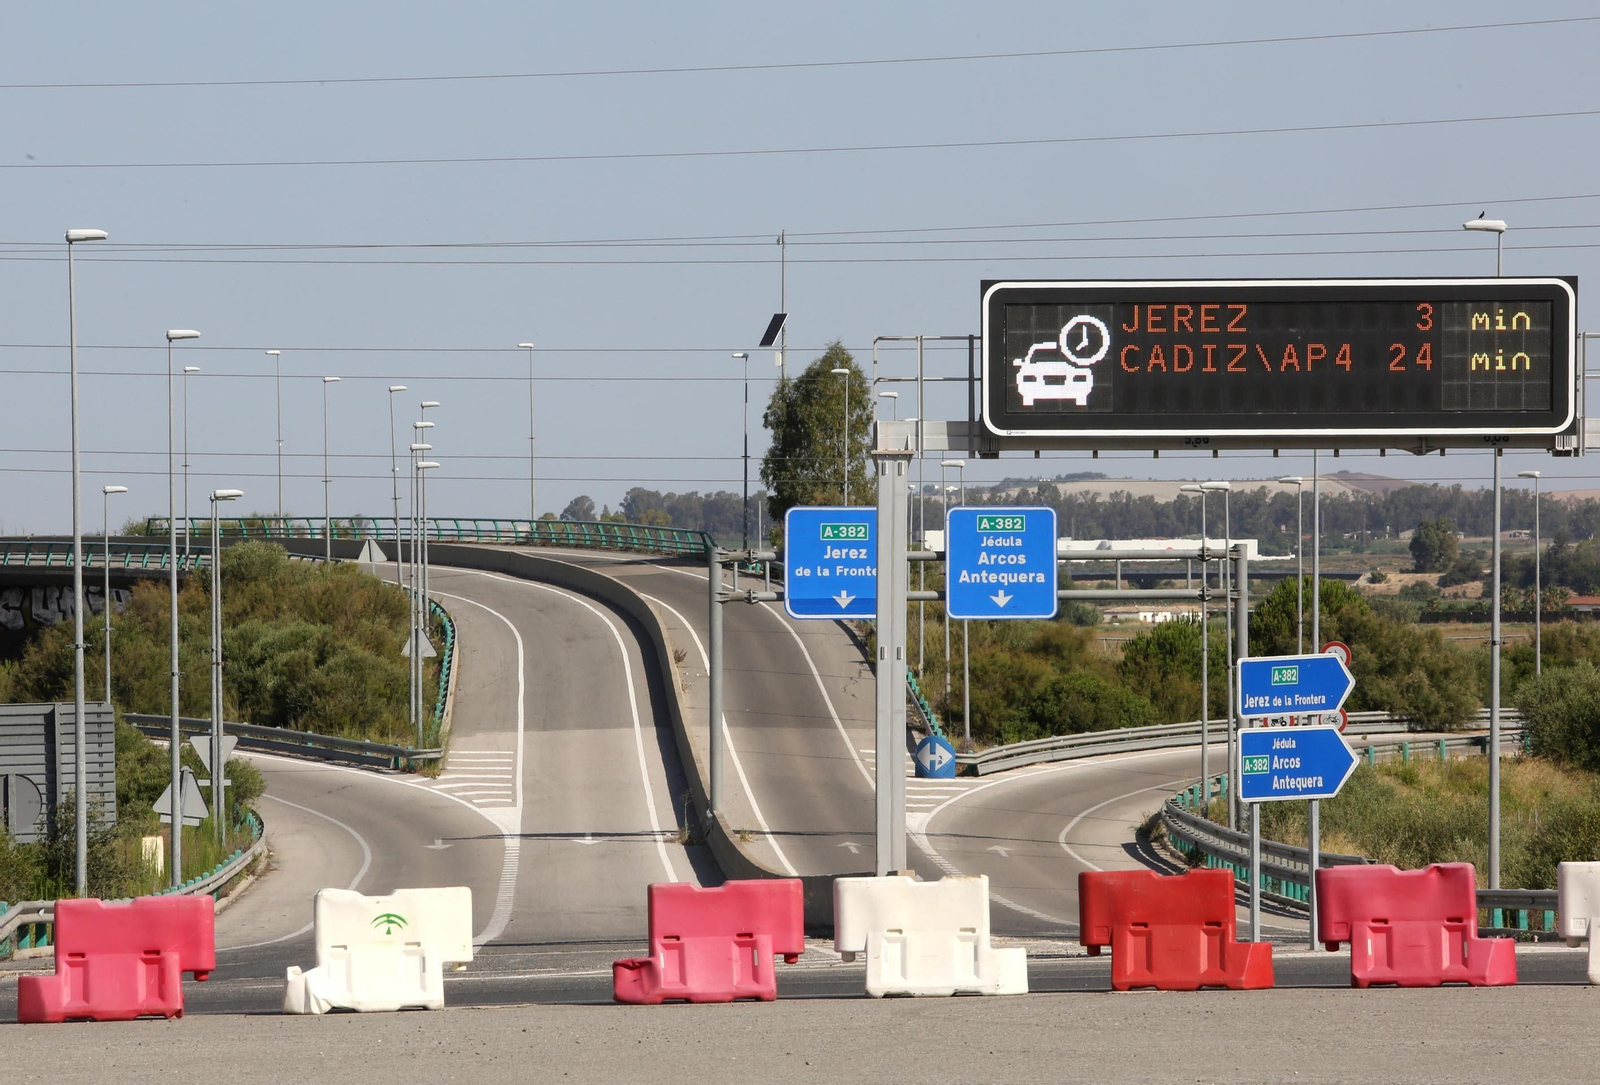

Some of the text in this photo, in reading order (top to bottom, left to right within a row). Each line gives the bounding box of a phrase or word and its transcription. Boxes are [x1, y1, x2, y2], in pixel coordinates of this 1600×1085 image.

[1122, 302, 1531, 333] JEREZ 3 min
[1389, 343, 1433, 371] 24
[1471, 349, 1531, 371] min
[980, 518, 1022, 529] A-382
[823, 526, 866, 537] A-382
[981, 536, 1023, 547] Jédula
[823, 545, 868, 559] Jerez
[977, 551, 1027, 565] Arcos
[795, 566, 811, 577] de
[817, 566, 830, 577] la
[958, 570, 1046, 586] Antequera
[1273, 669, 1298, 682] A-382
[1244, 693, 1326, 708] Jerez de la Frontera
[1272, 737, 1296, 750] Jédula
[1244, 758, 1268, 772] A-382
[1272, 755, 1301, 770] Arcos
[1272, 775, 1323, 792] Antequera
